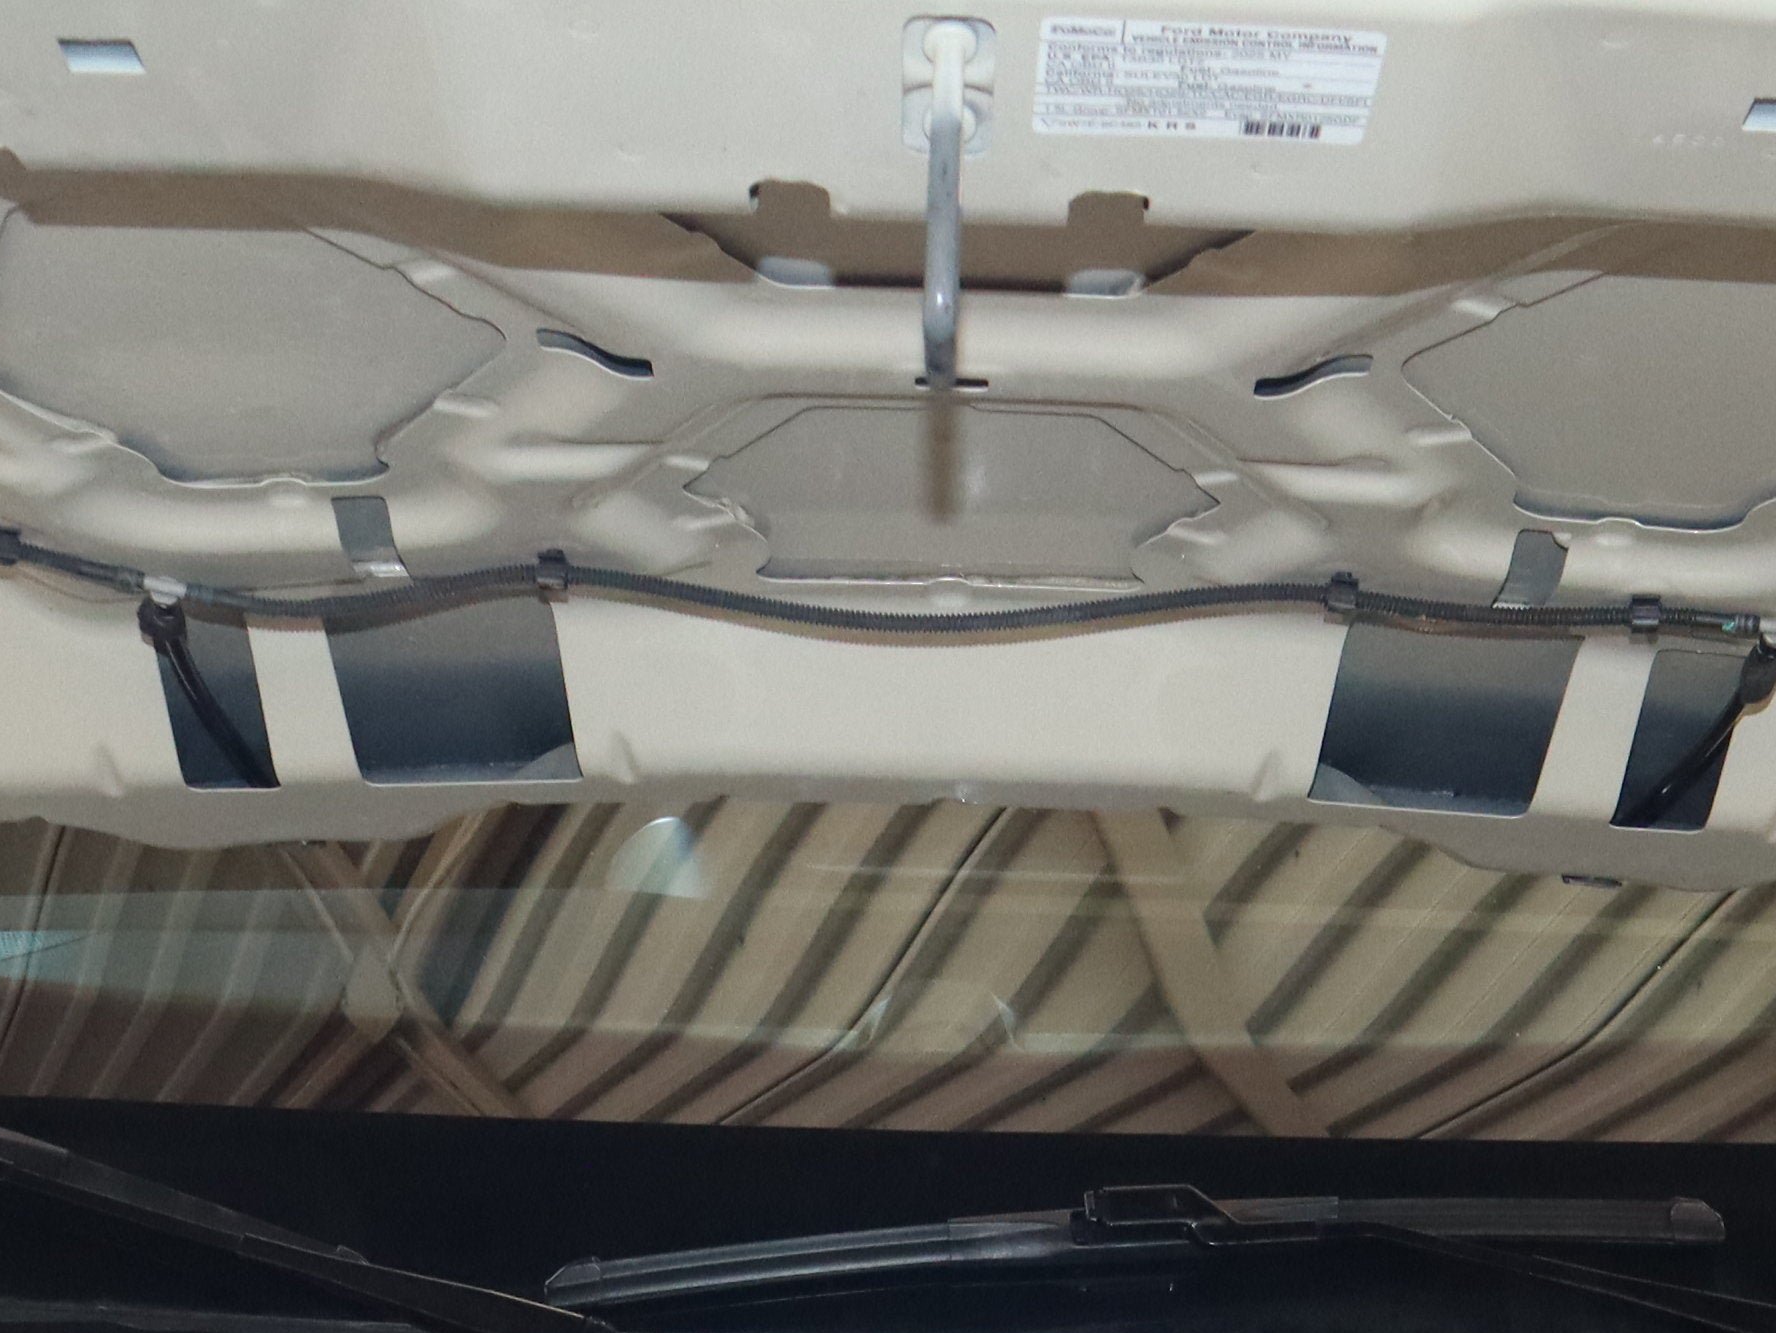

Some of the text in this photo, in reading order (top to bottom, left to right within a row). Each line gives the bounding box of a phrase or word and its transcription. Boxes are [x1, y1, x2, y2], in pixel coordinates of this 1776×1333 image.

[1161, 25, 1351, 43] Ford Motor Company
